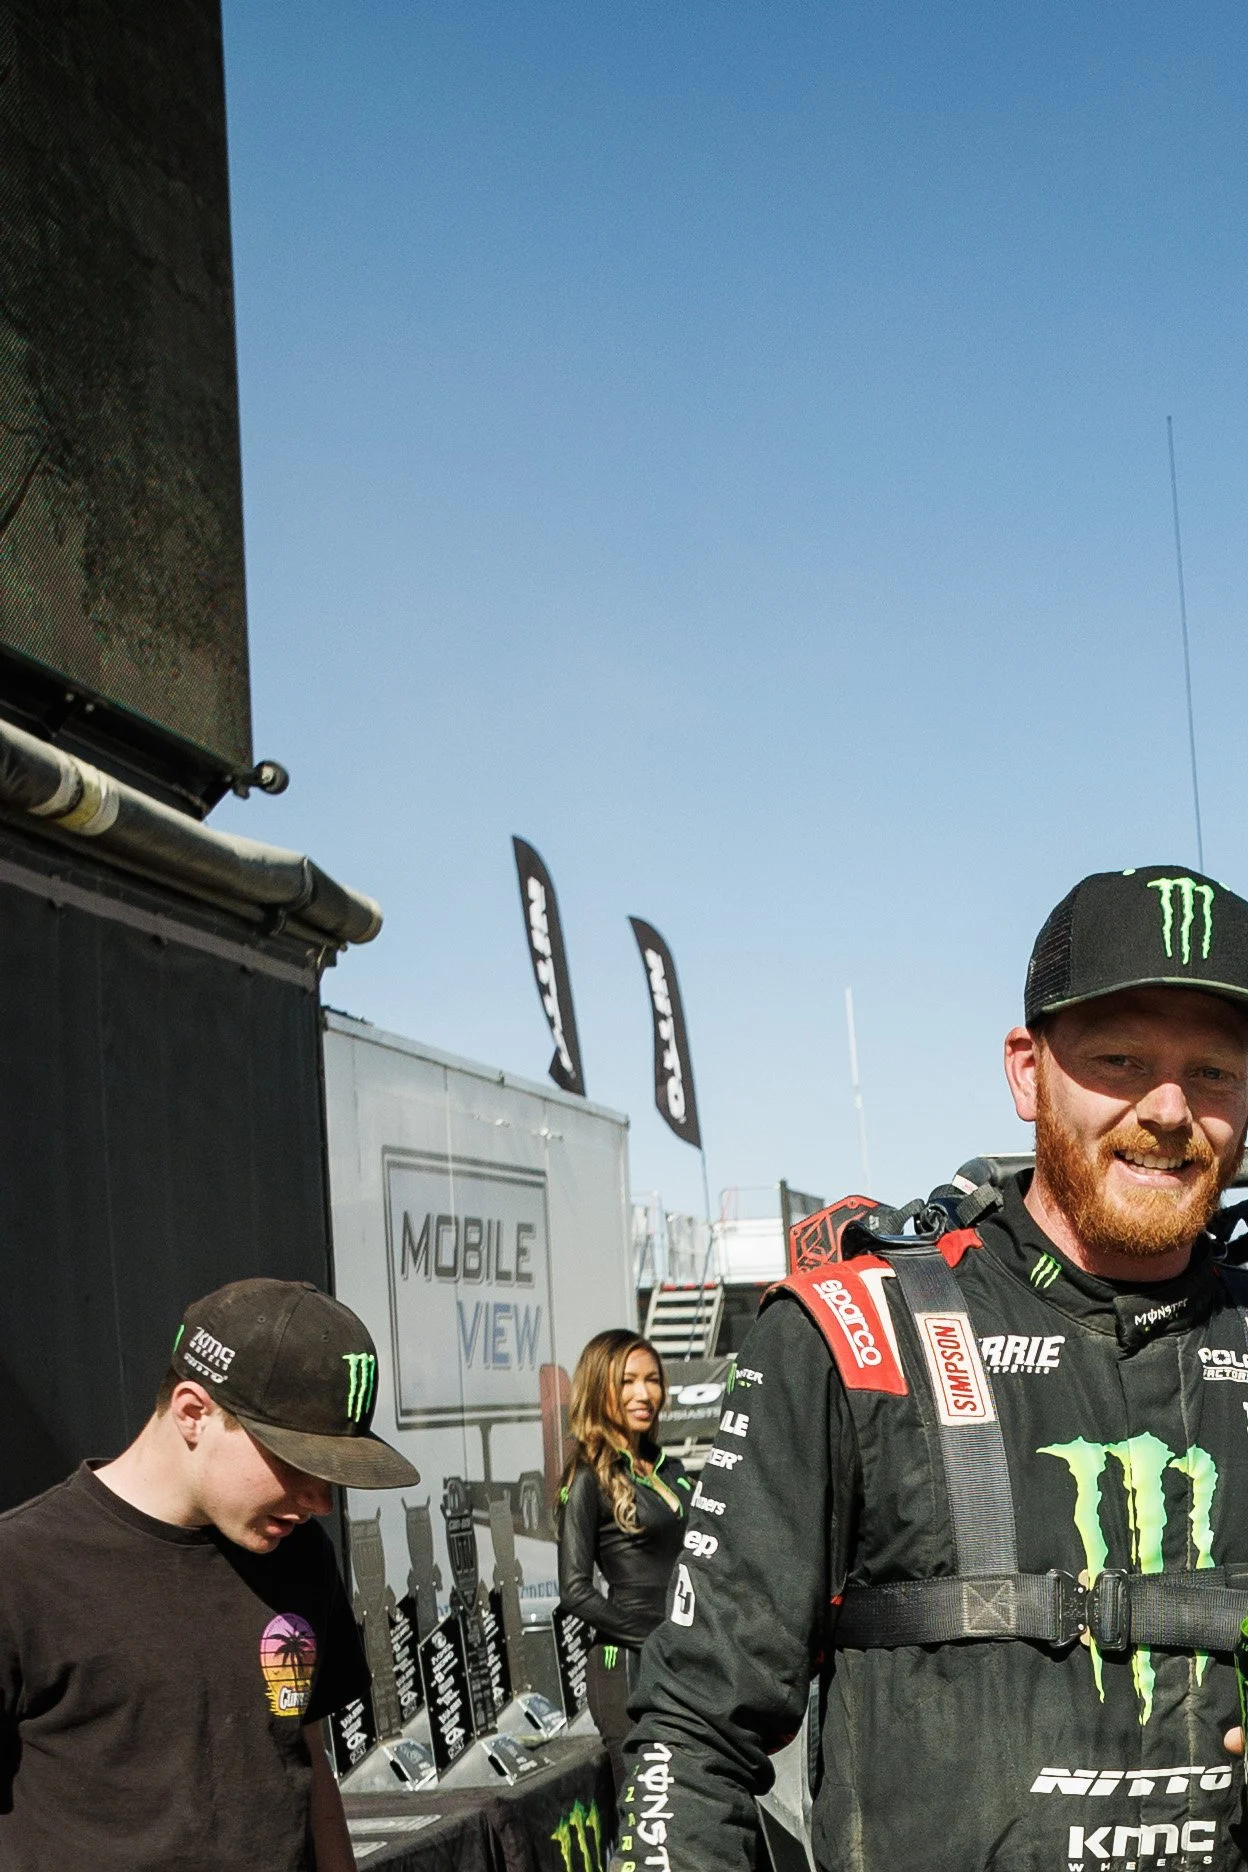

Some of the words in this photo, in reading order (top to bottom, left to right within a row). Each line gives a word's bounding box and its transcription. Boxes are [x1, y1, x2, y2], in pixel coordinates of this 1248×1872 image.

[645, 948, 686, 1124] NITTO
[401, 1211, 537, 1289] MOBILE
[456, 1300, 543, 1371] VIEW
[812, 1279, 882, 1369] sparco
[978, 1334, 1066, 1368] RRIE
[932, 1324, 977, 1412] SIMPSON
[1030, 1765, 1232, 1797] NITTO
[1068, 1821, 1217, 1859] KMC
[1068, 1855, 1213, 1872] WHEELS
